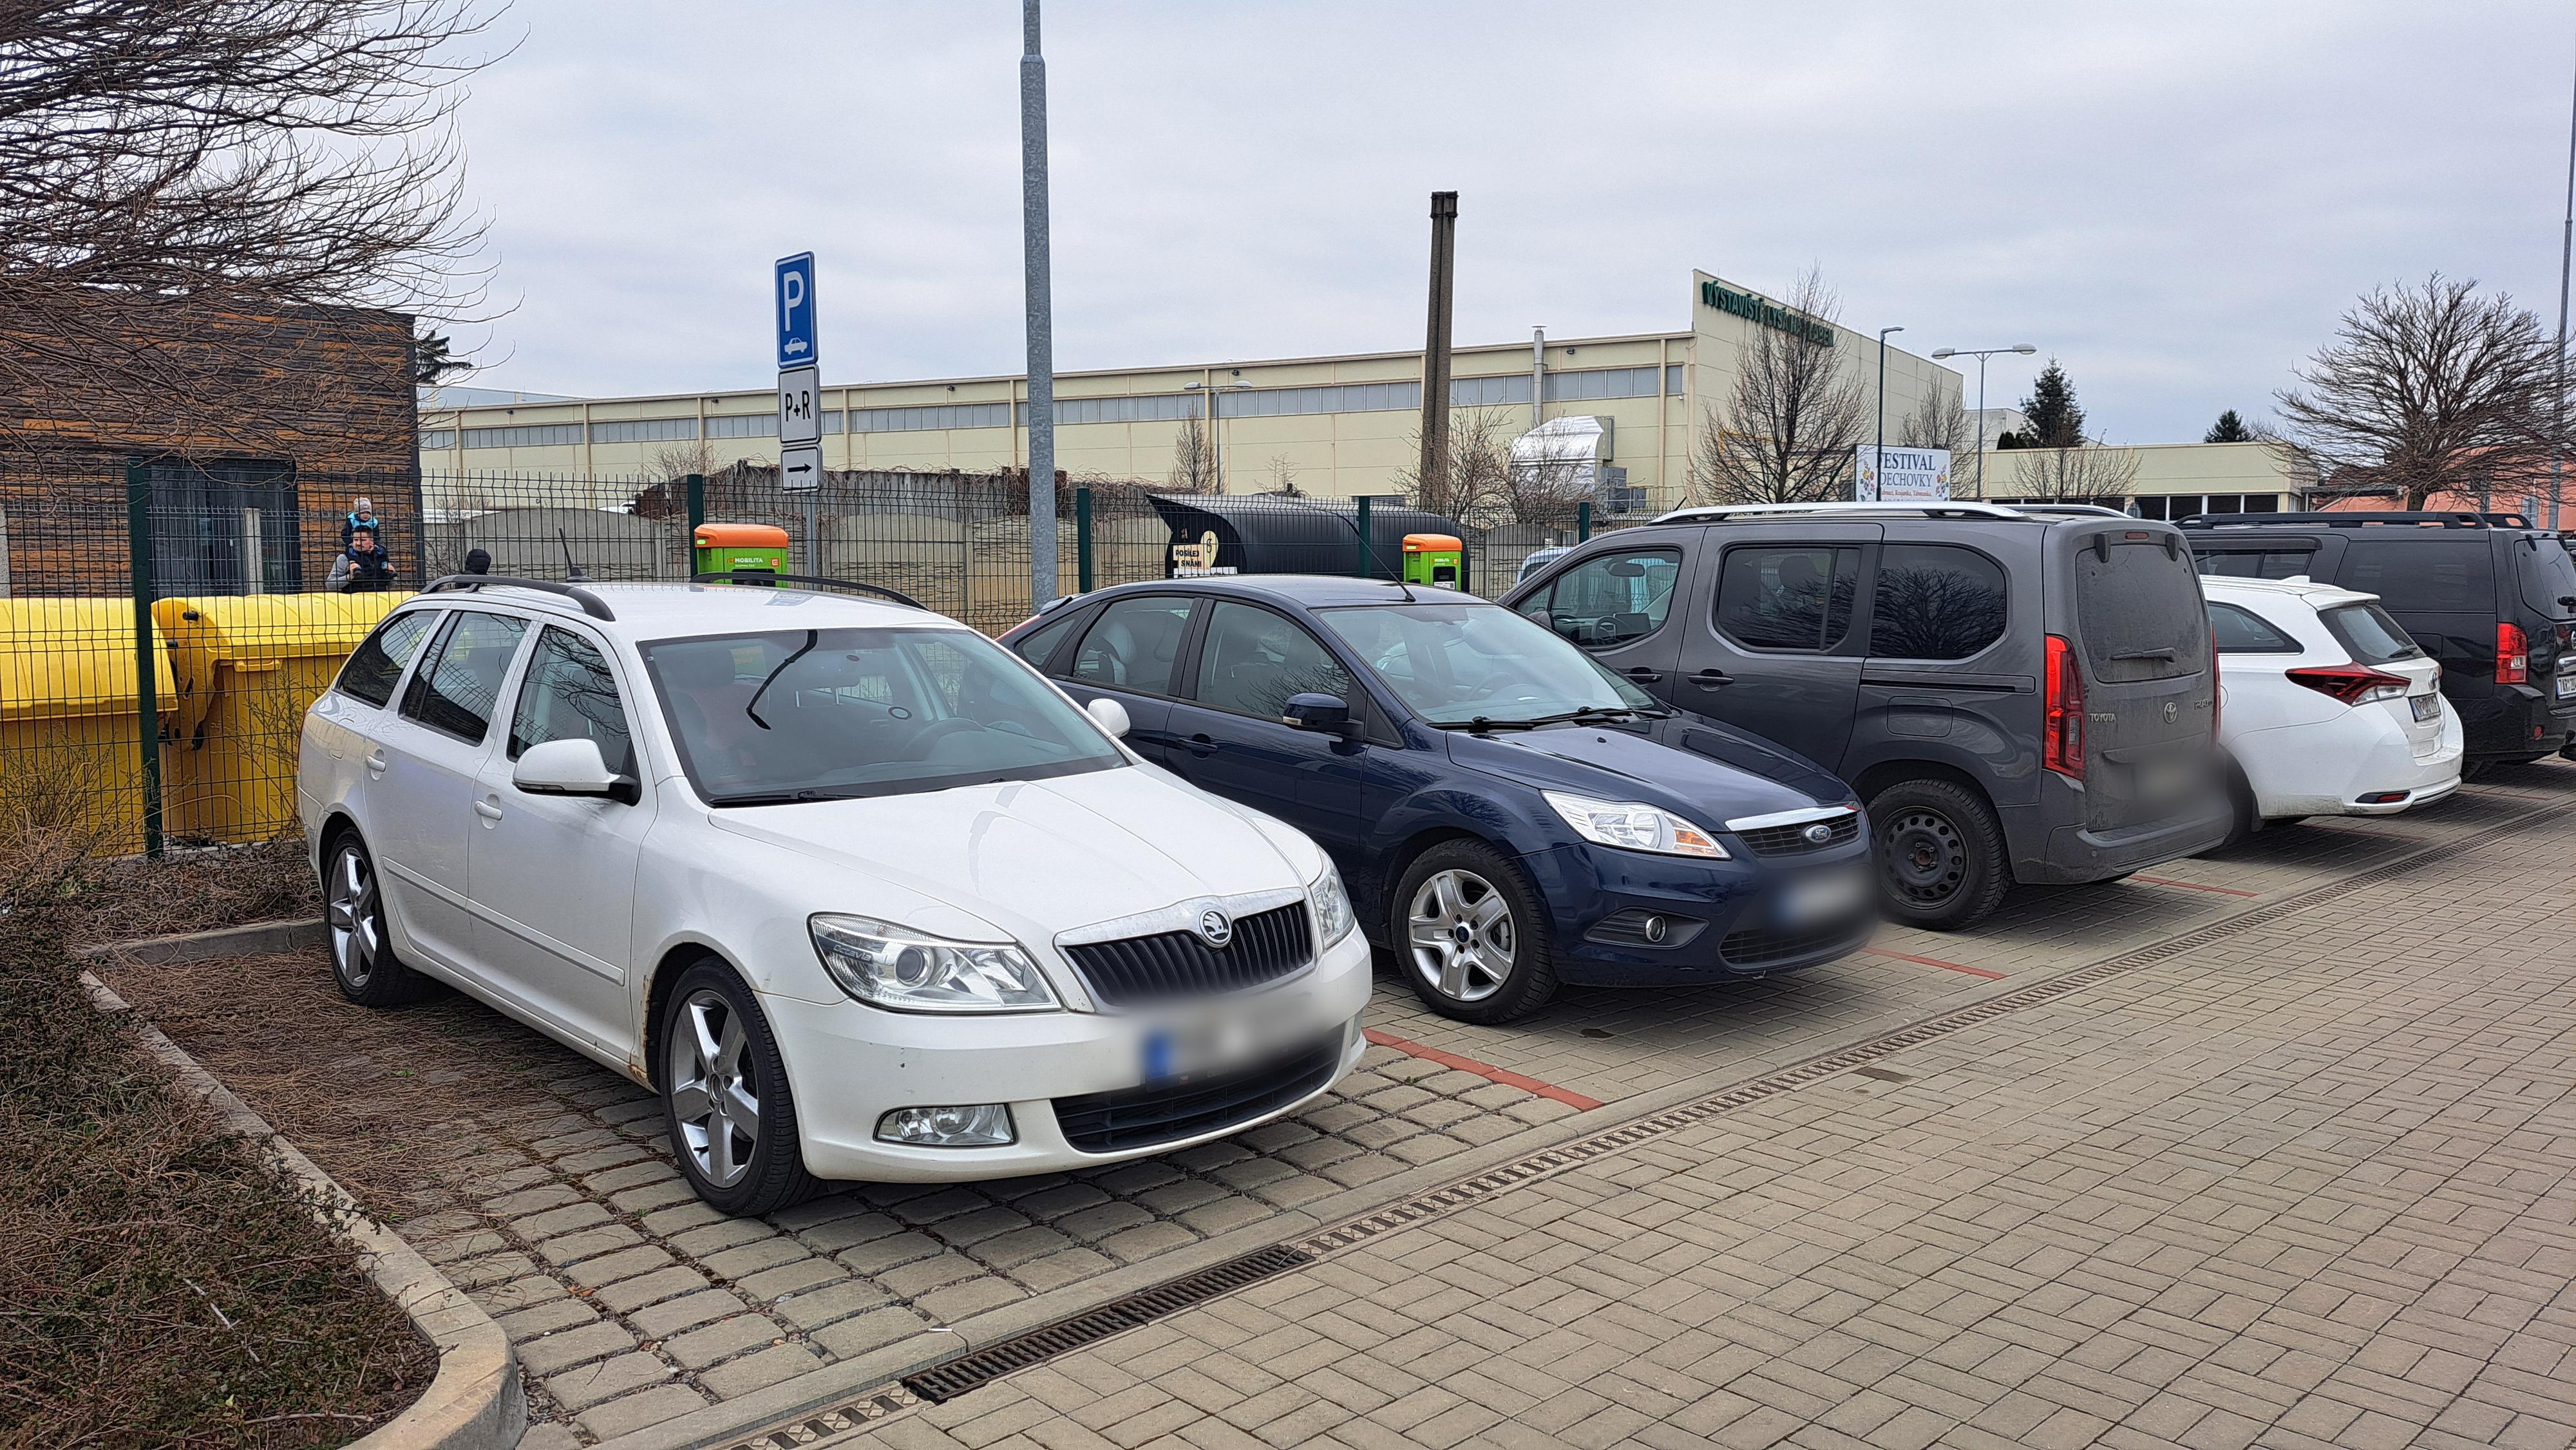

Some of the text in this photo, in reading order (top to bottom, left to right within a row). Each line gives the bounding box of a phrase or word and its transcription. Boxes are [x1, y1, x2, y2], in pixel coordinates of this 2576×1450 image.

[783, 270, 804, 332] P
[785, 390, 811, 422] P+R
[1175, 548, 1200, 557] POSÍLEJ
[2089, 713, 2116, 722] TOYOTA
